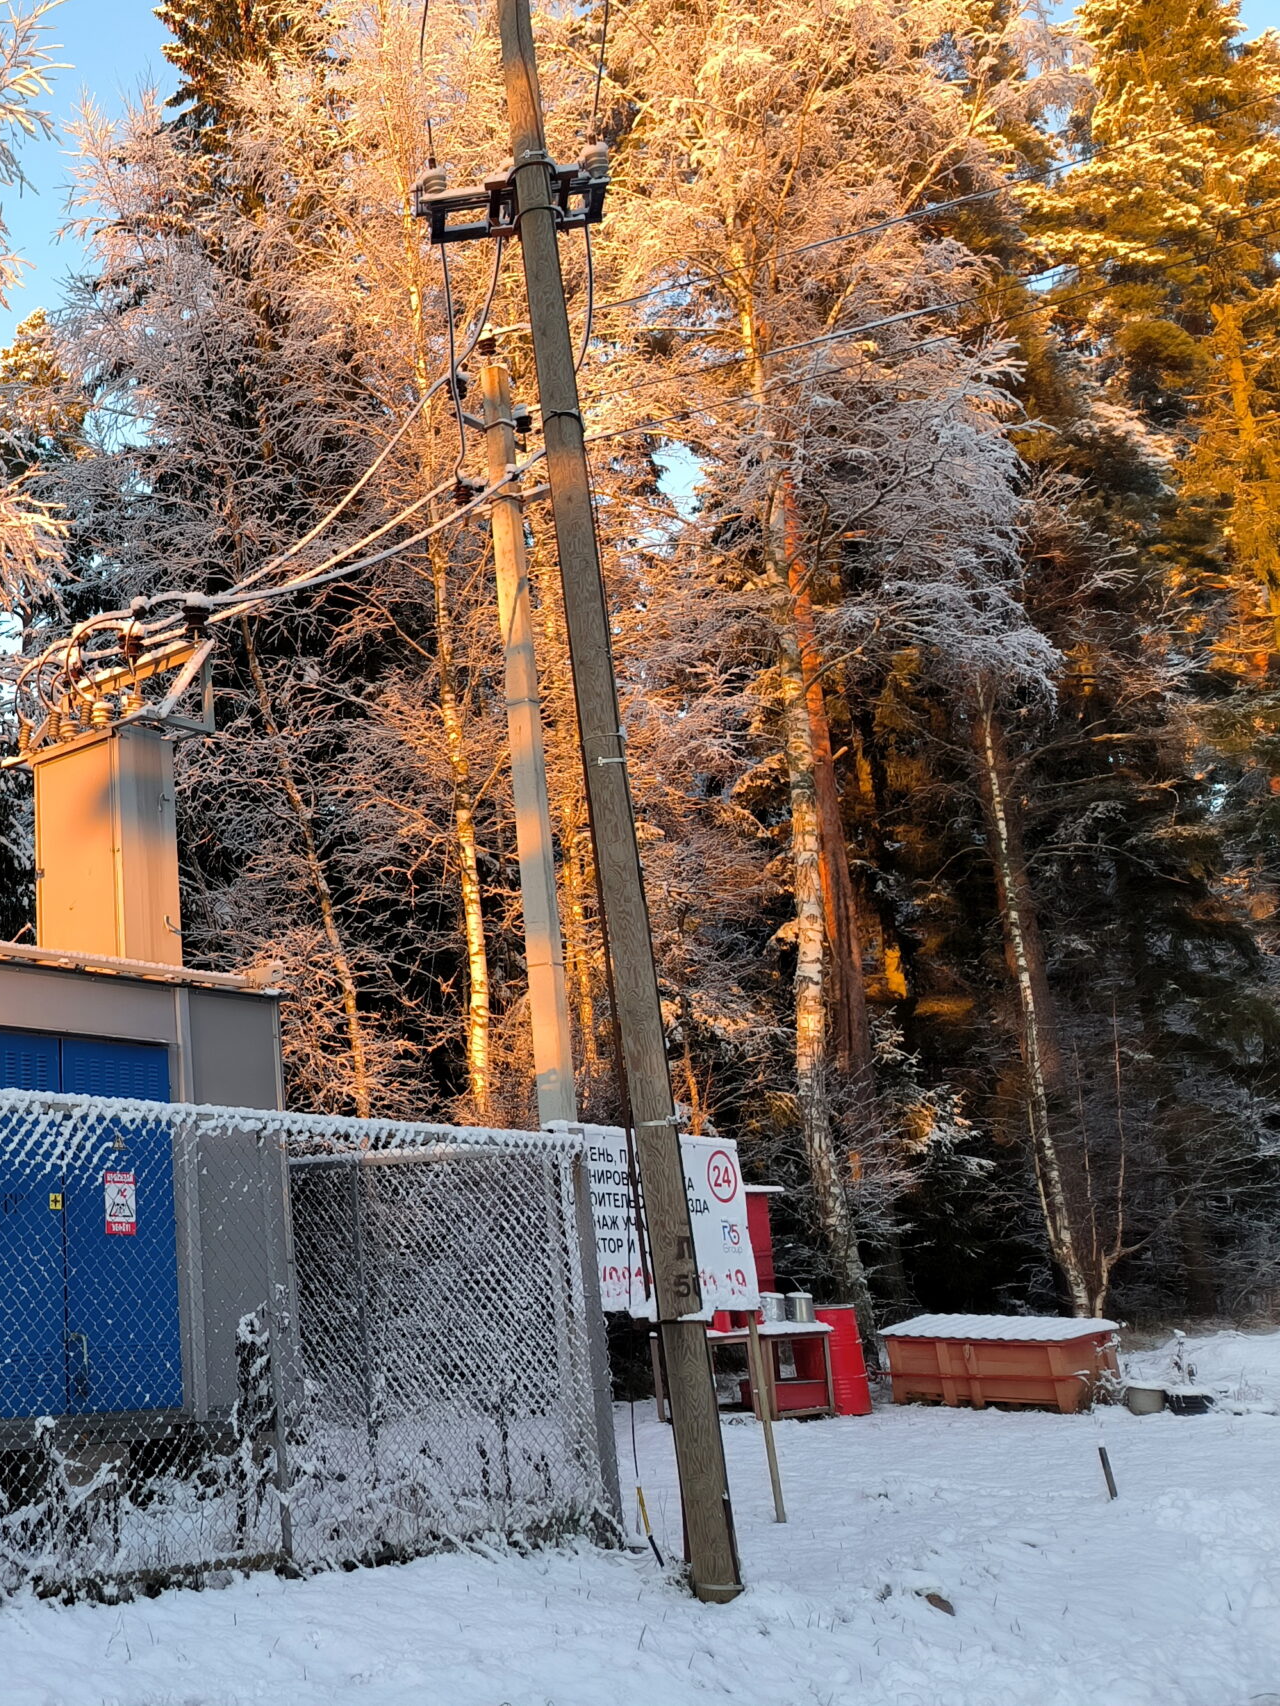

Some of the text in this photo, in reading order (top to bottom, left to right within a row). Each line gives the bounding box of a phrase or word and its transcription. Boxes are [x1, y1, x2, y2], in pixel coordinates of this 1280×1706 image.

[589, 1146, 617, 1166] ЕНЬ,
[712, 1165, 731, 1188] 24
[594, 1214, 620, 1231] НАЖ
[722, 1219, 740, 1246] R5
[596, 1238, 624, 1254] КТОР
